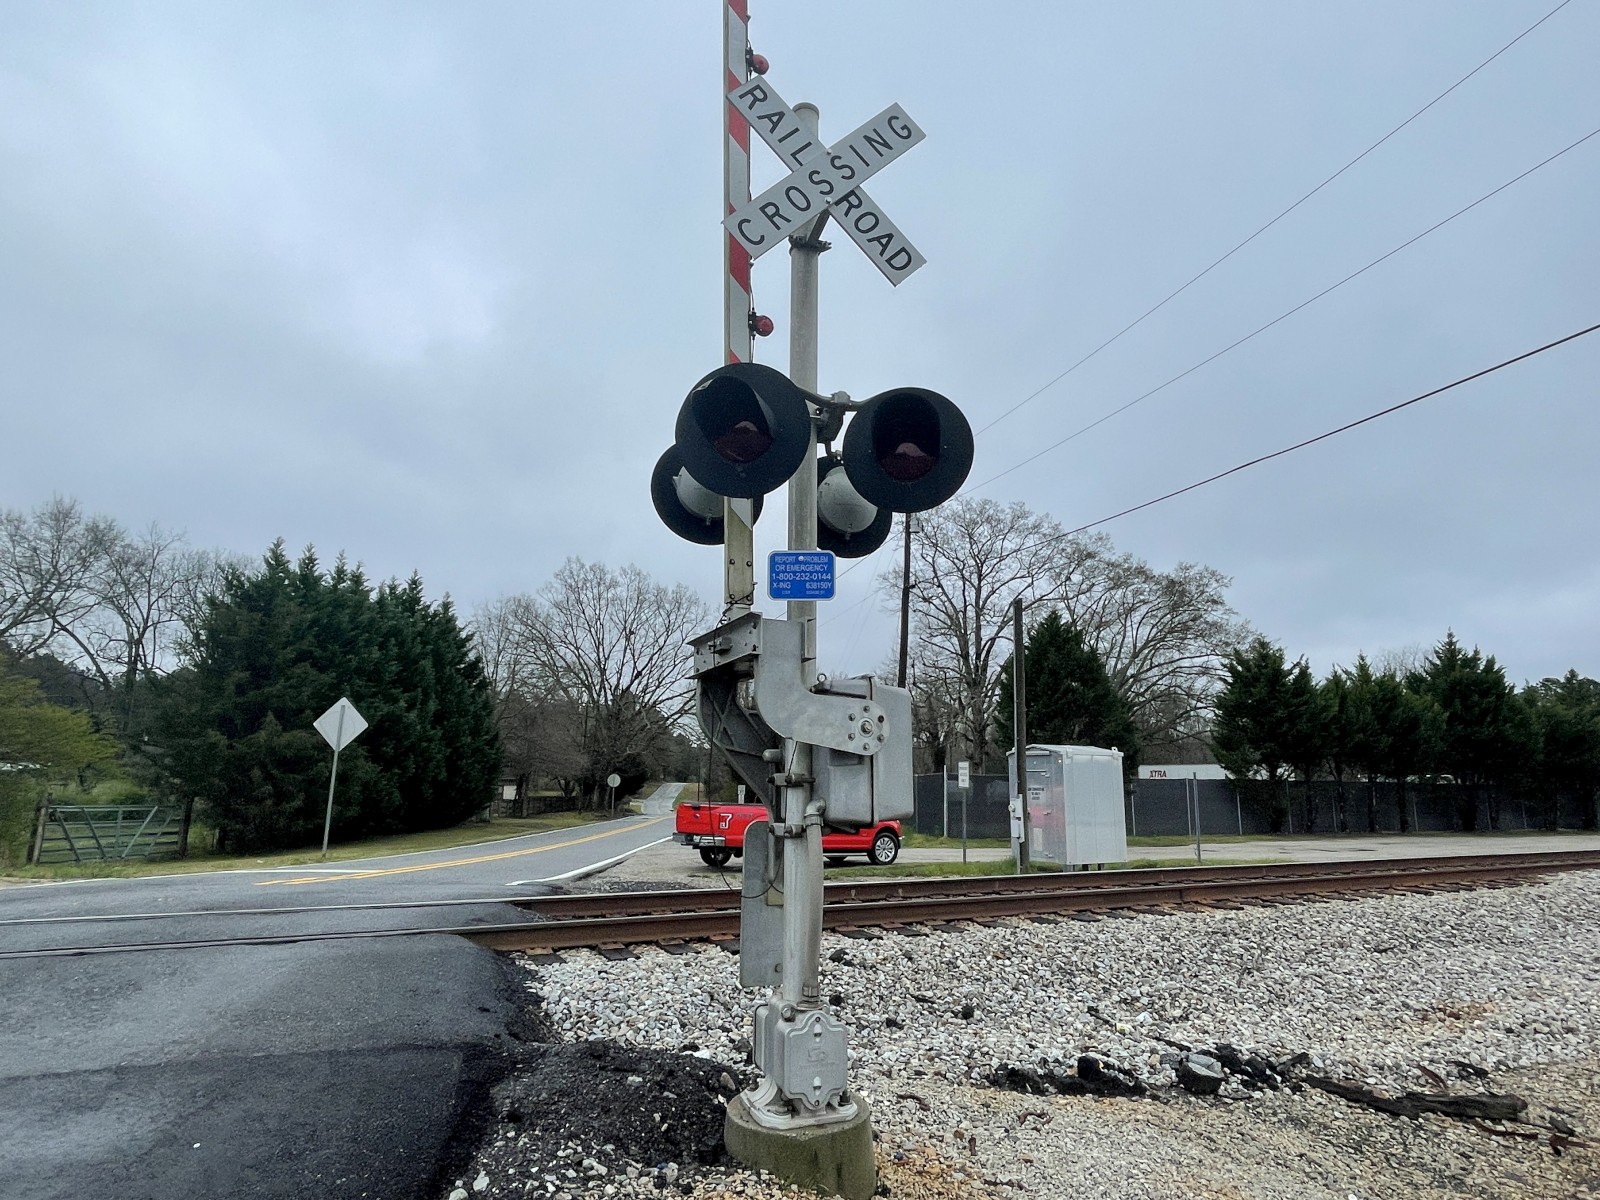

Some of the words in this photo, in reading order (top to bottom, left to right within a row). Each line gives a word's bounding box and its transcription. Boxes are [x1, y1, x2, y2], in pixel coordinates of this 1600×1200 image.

[738, 83, 813, 167] RAIL
[737, 115, 913, 246] CROSSING
[833, 190, 912, 271] ROAD
[775, 564, 786, 572] OR
[786, 564, 828, 572] EMERGENCY
[1149, 769, 1167, 779] XTRA
